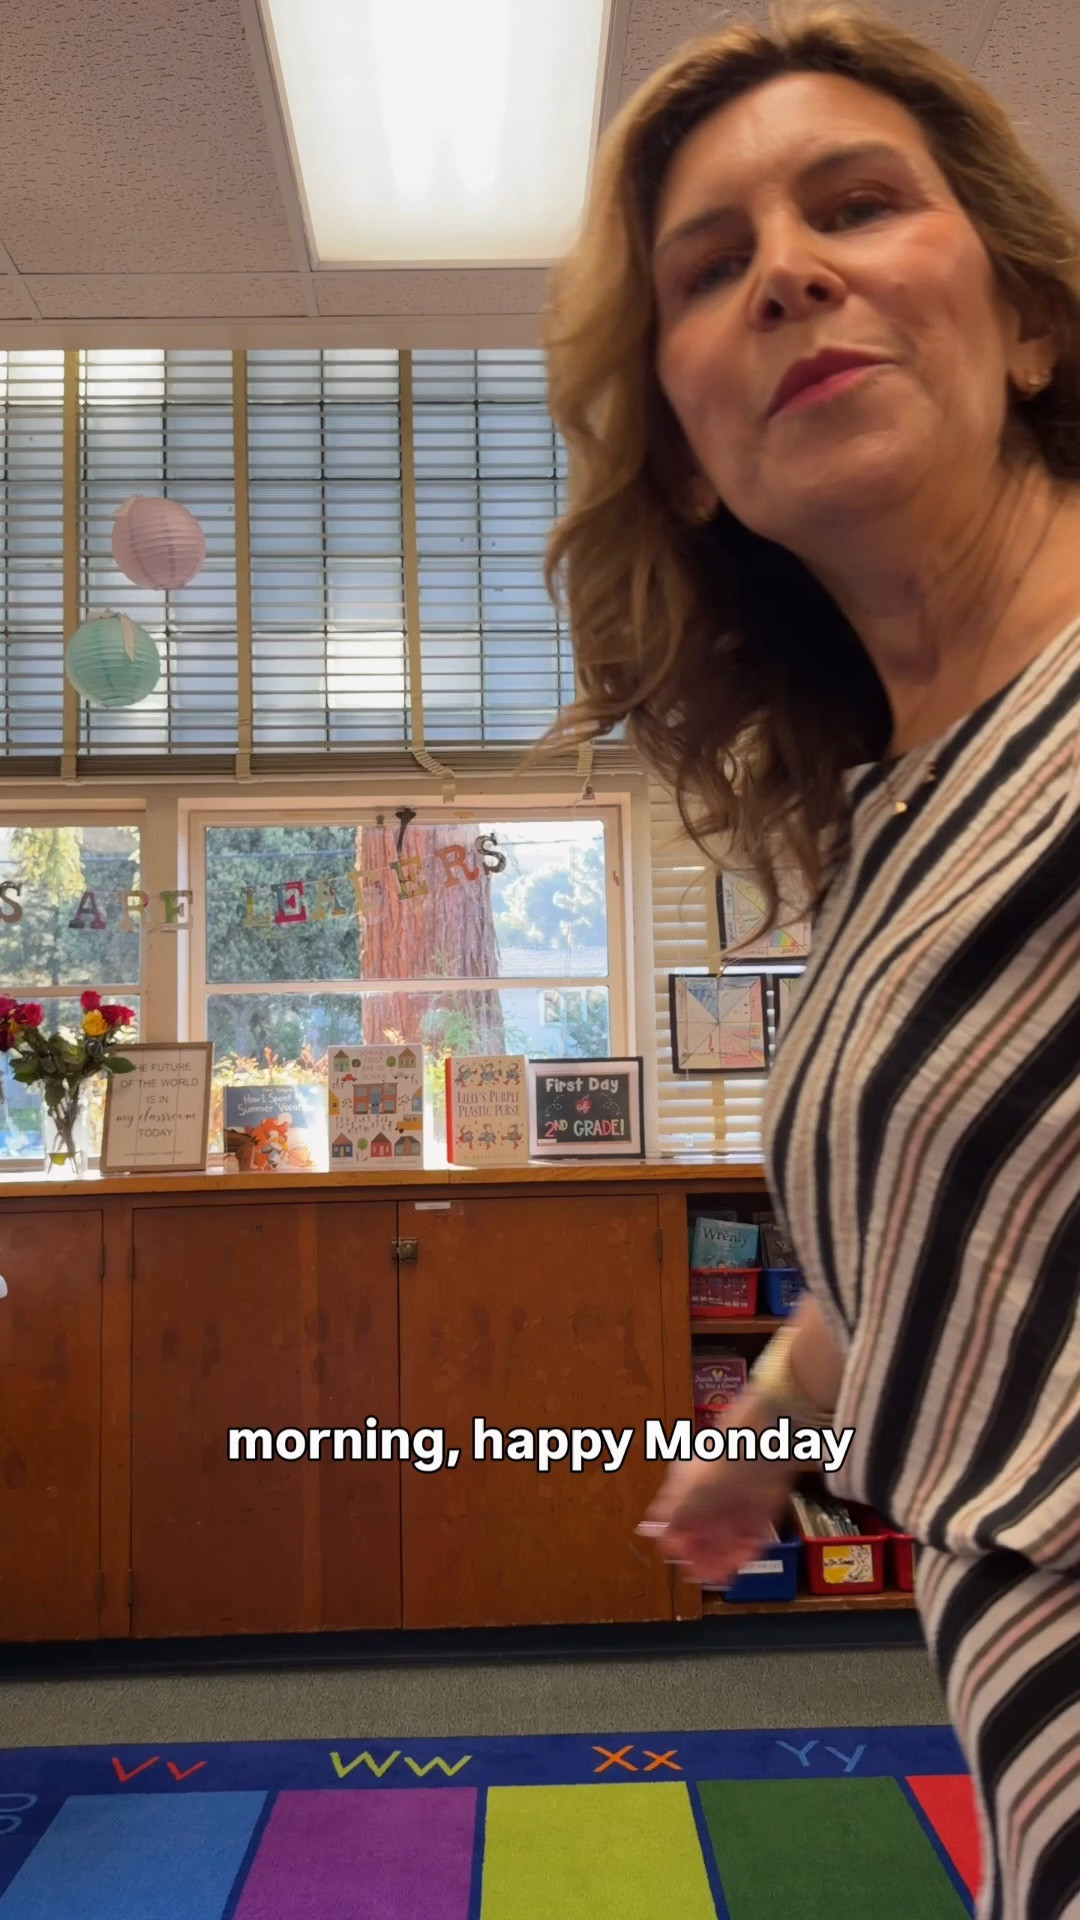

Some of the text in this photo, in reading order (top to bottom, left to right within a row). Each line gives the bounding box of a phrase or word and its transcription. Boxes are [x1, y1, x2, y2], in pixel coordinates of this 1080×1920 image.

[69, 889, 193, 933] ARE
[243, 832, 507, 929] LEADERS
[151, 1062, 191, 1073] FUTURE
[120, 1077, 199, 1089] OF THE WORLD
[545, 1076, 619, 1094] First Day
[146, 1095, 169, 1104] IS IN
[243, 1093, 261, 1104] How
[268, 1092, 291, 1106] Spent
[490, 1090, 520, 1103] PURPLE
[237, 1103, 273, 1116] Summer
[459, 1104, 521, 1117] PLASTIC PURSE
[576, 1101, 590, 1114] of
[116, 1106, 196, 1128] my classroom
[139, 1128, 173, 1138] TODAY
[545, 1119, 624, 1137] 2ND GRADE!
[703, 1227, 747, 1248] Wrenly
